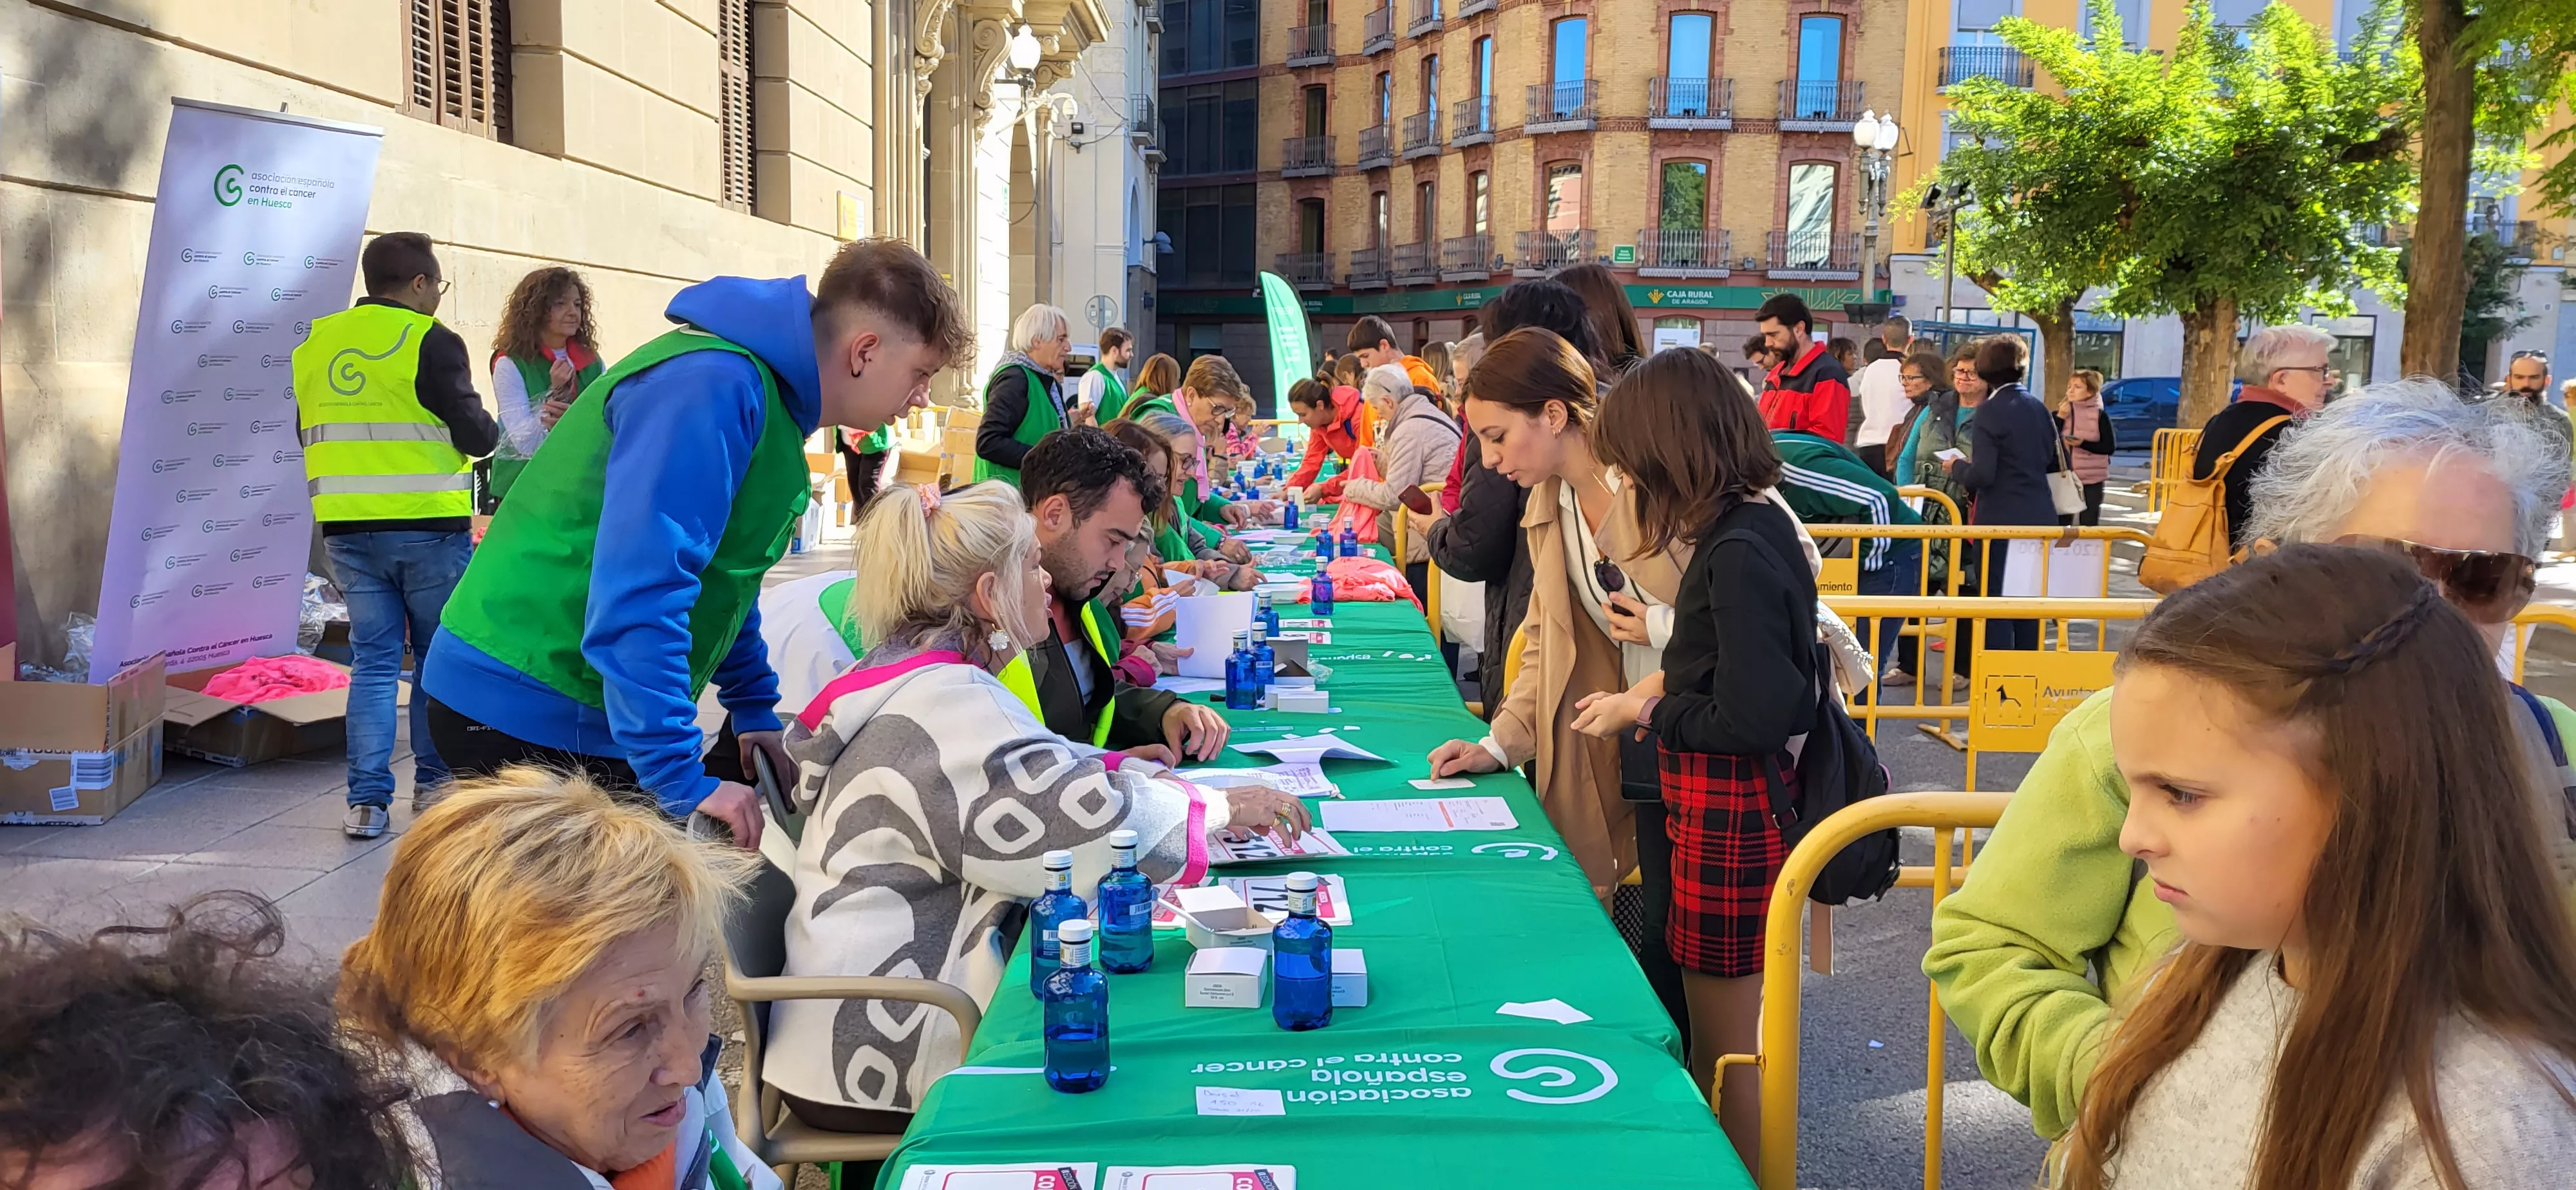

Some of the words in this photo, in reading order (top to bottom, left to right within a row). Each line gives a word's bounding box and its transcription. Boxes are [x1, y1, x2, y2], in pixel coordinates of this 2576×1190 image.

[251, 172, 296, 184] asociación
[298, 177, 335, 189] española
[249, 184, 278, 194] contra
[280, 186, 288, 196] el
[289, 187, 316, 198] cáncer
[247, 197, 258, 205] en
[261, 197, 292, 209] Huesca
[1191, 1058, 1307, 1074] cáncer
[1317, 1055, 1345, 1069] el
[1354, 1053, 1463, 1064] contra
[1312, 1069, 1468, 1085] española
[1287, 1087, 1472, 1105] asociación
